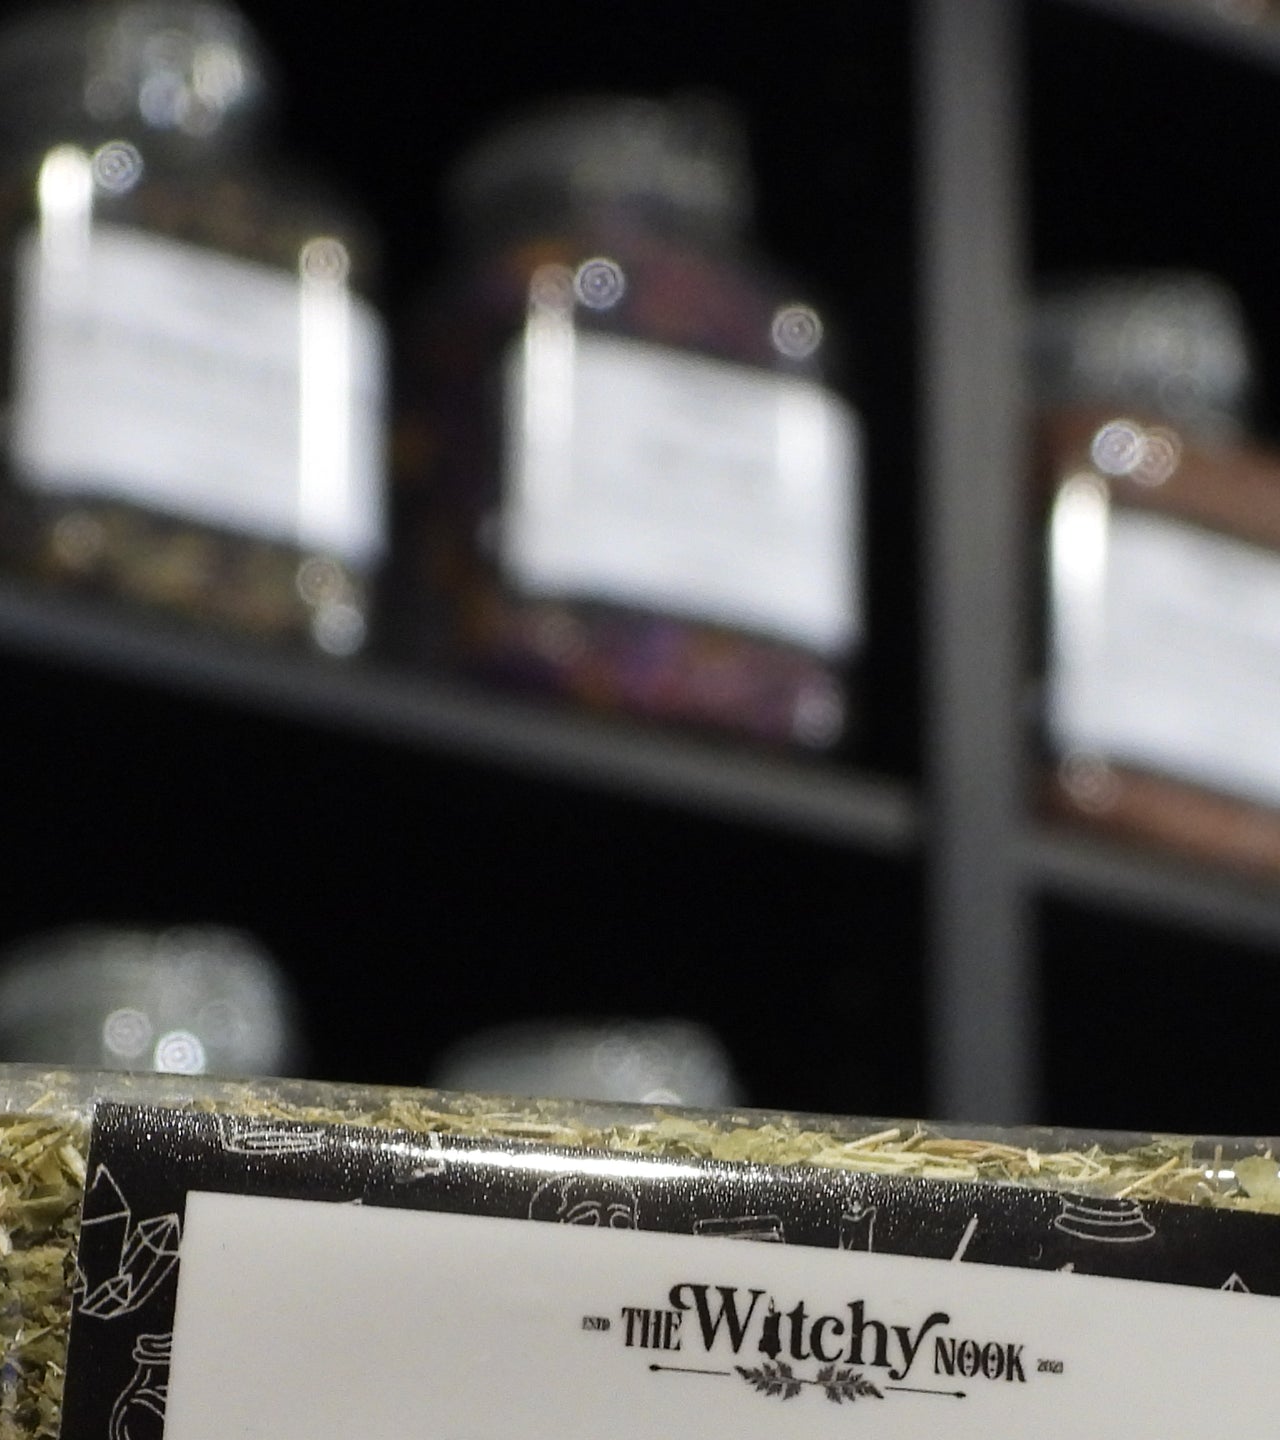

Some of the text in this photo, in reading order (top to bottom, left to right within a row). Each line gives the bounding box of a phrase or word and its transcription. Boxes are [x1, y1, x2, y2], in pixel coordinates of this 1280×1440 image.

[621, 1307, 682, 1351] THE
[669, 1283, 951, 1381] Witchy
[933, 1336, 1028, 1384] NOOK
